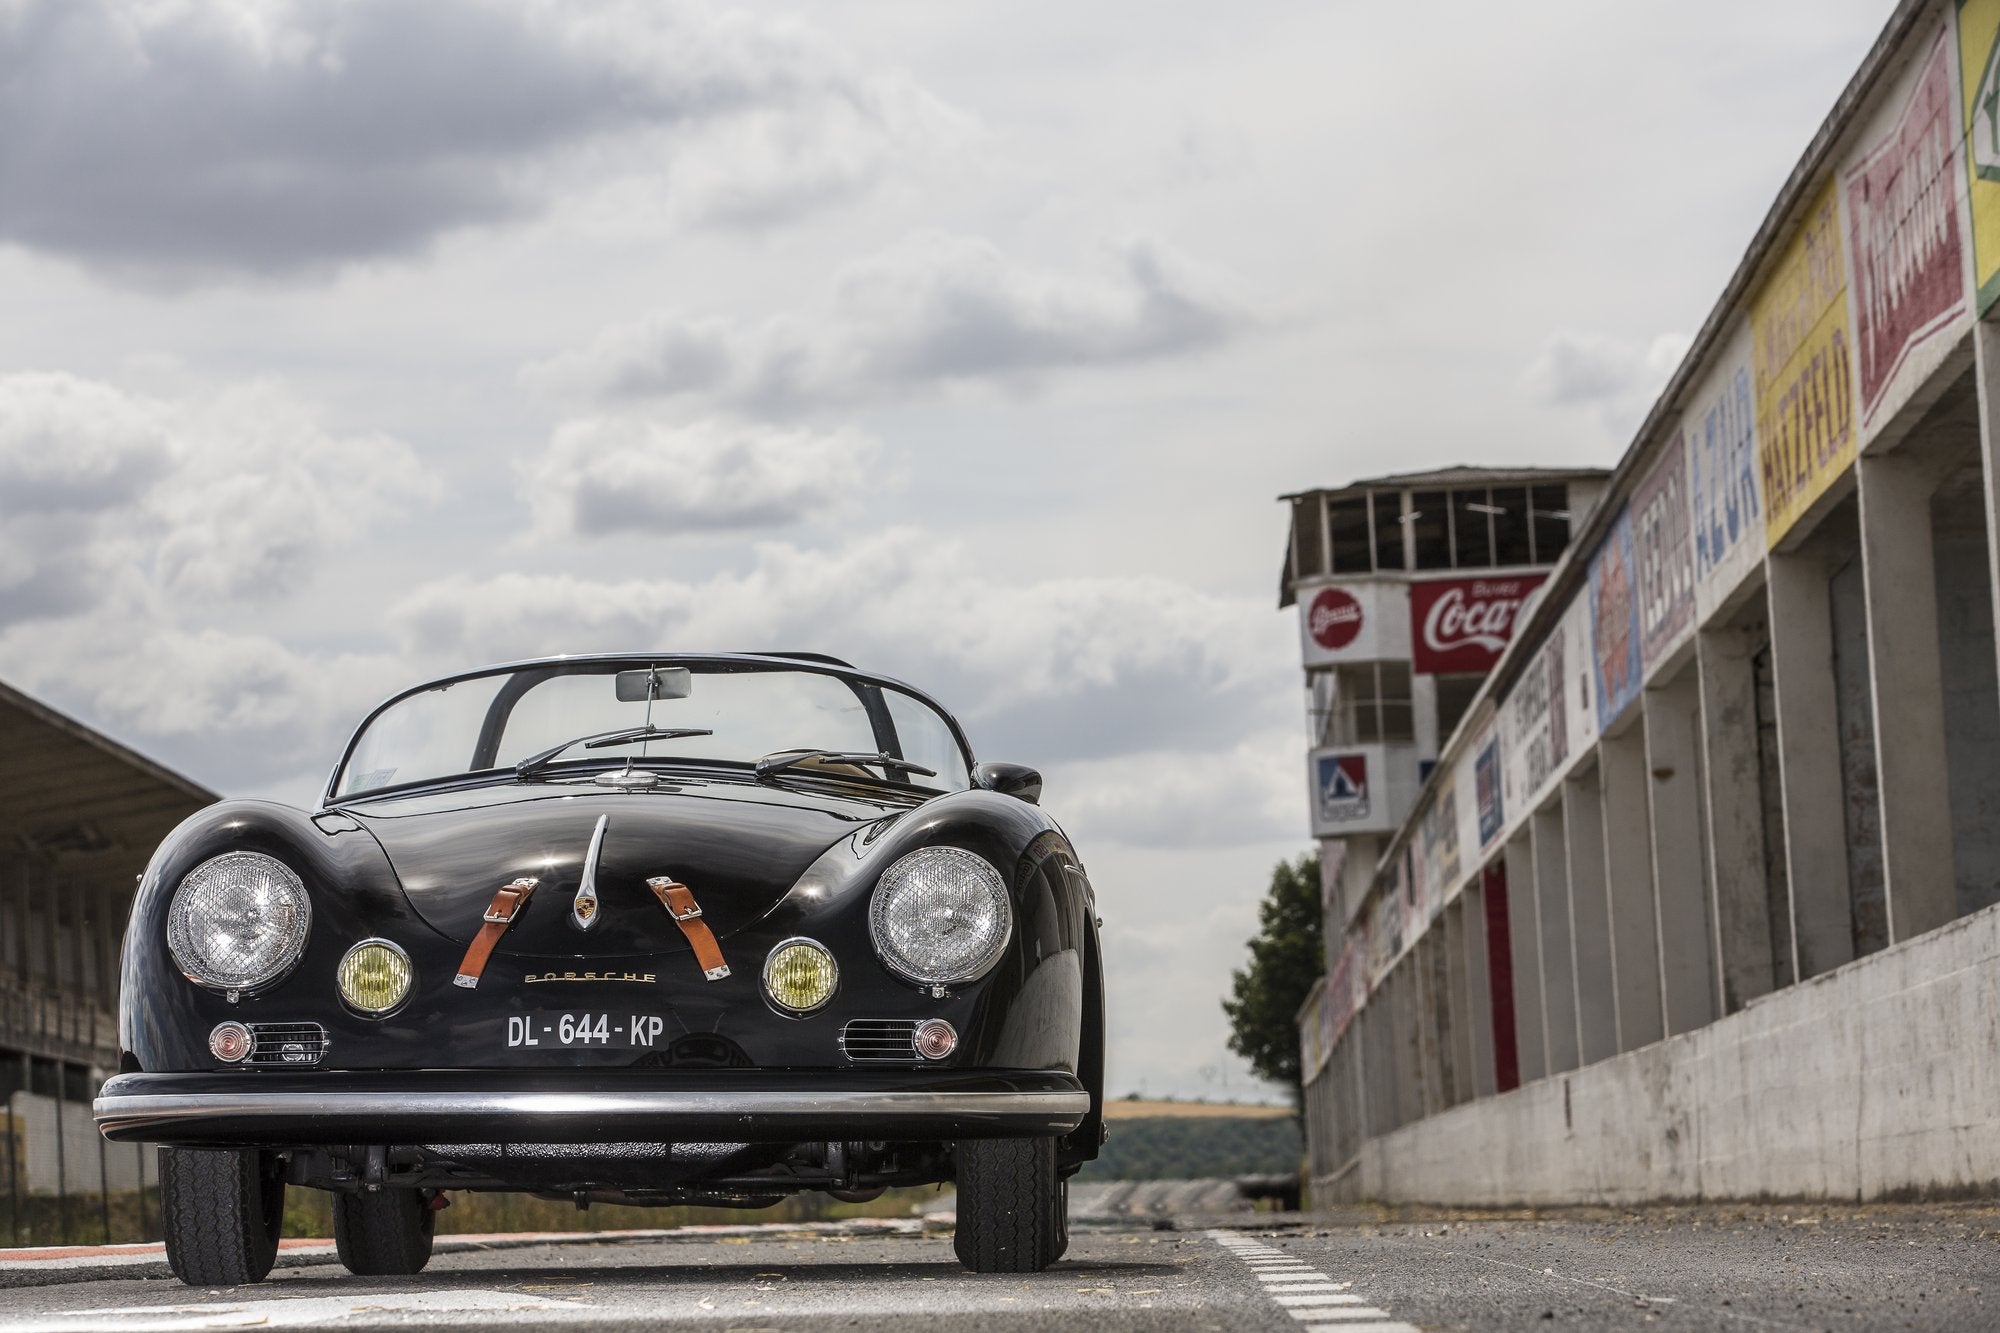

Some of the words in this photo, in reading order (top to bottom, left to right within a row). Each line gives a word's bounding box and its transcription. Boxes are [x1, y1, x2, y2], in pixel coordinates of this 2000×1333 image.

[1694, 367, 1758, 582] AZUR
[1760, 328, 1850, 527] HATZFELD
[524, 972, 656, 983] PORSCHE
